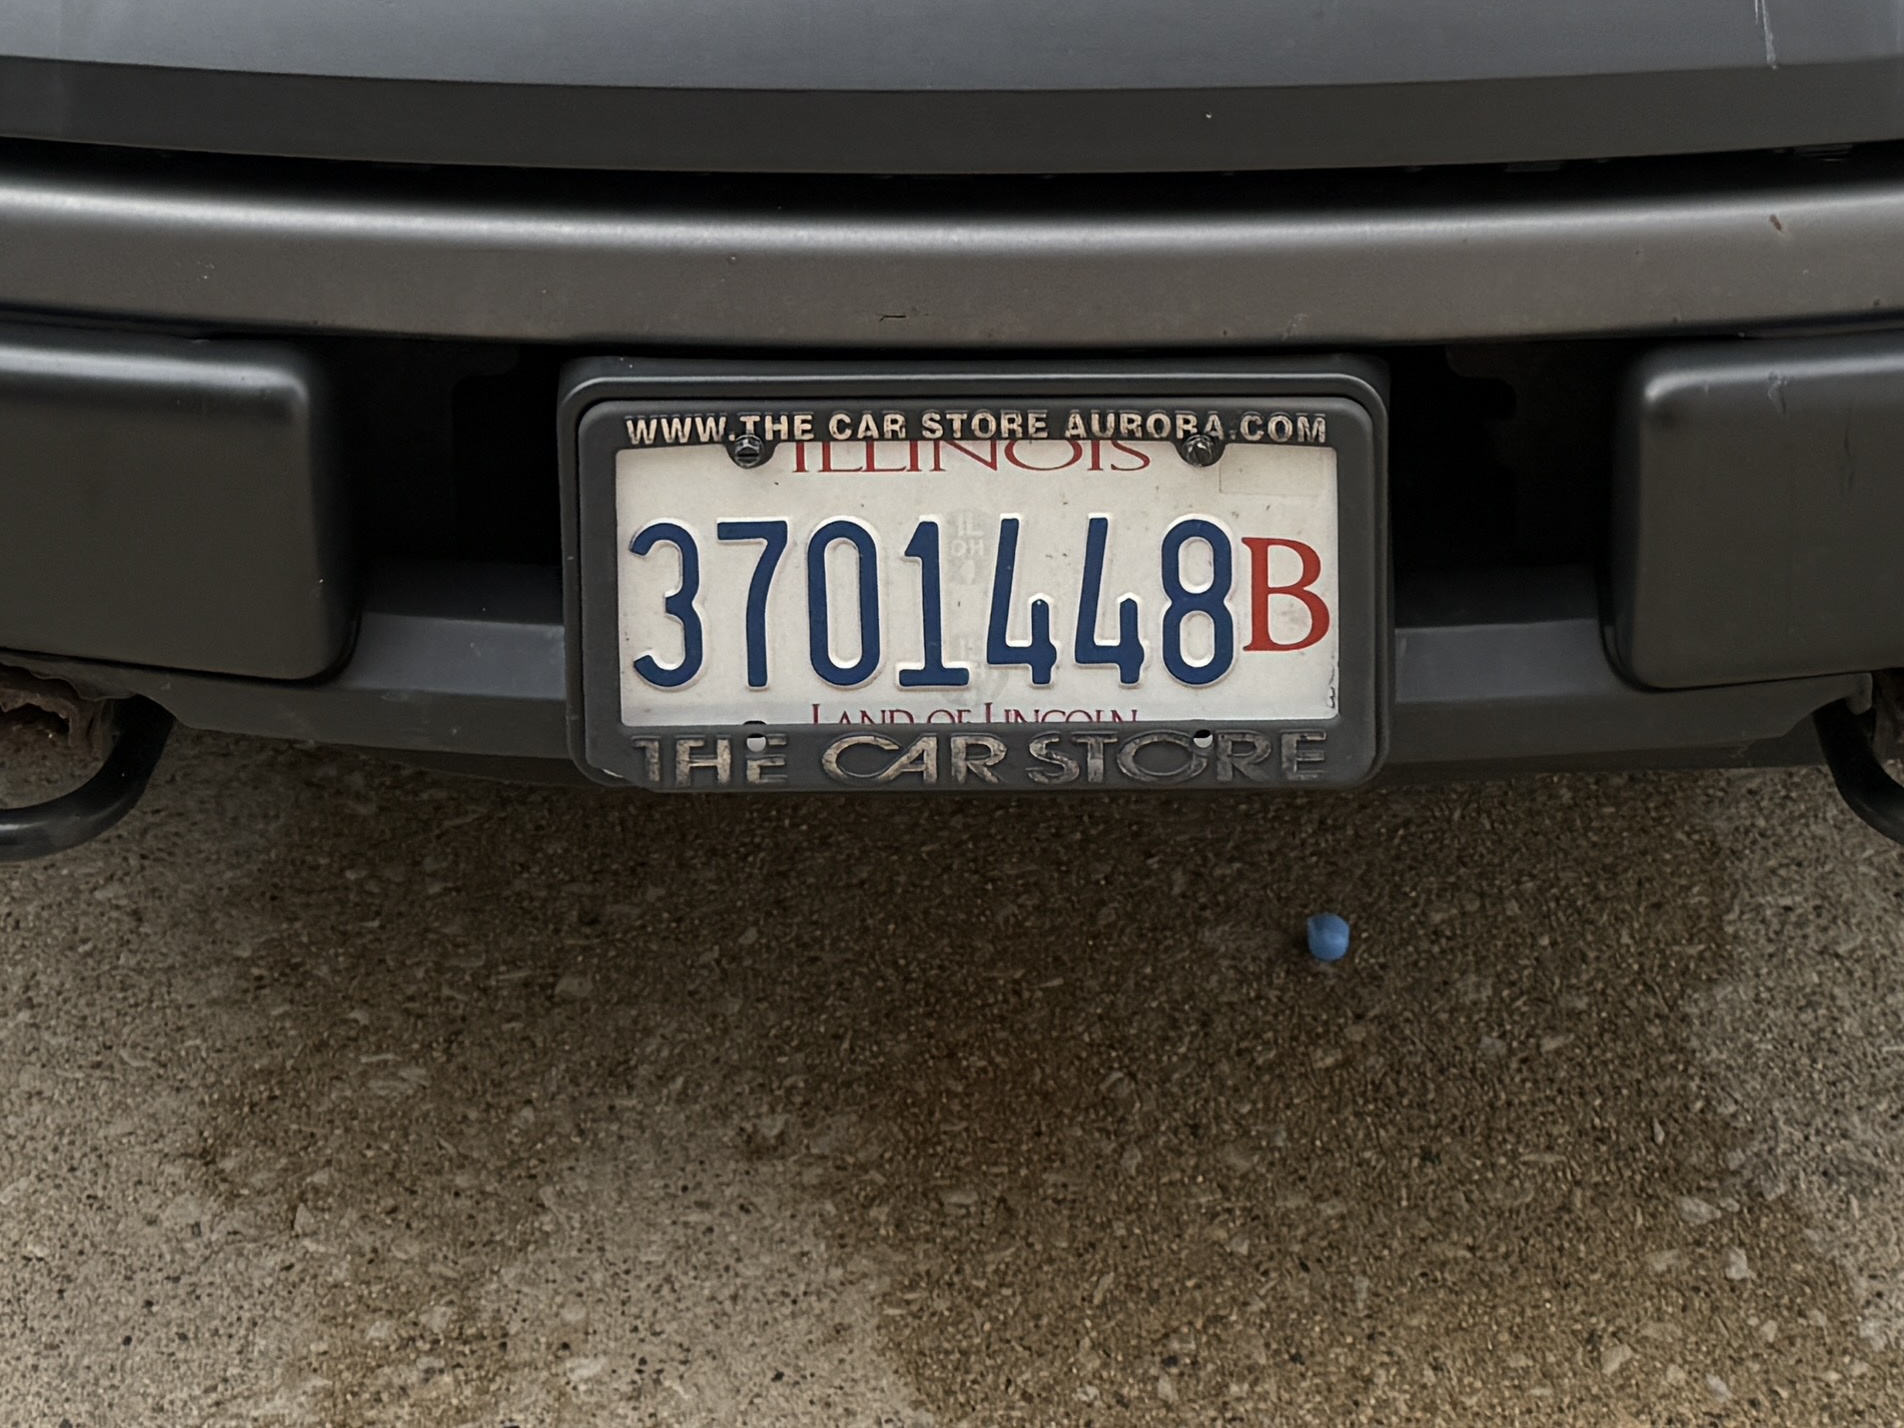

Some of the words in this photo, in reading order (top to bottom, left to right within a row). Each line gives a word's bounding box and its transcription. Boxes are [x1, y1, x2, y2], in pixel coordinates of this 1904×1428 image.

[828, 412, 907, 441] CAR
[921, 411, 1048, 440] STORE
[630, 732, 788, 788] THE
[821, 730, 1008, 787] CAR
[1025, 729, 1328, 786] STORE
